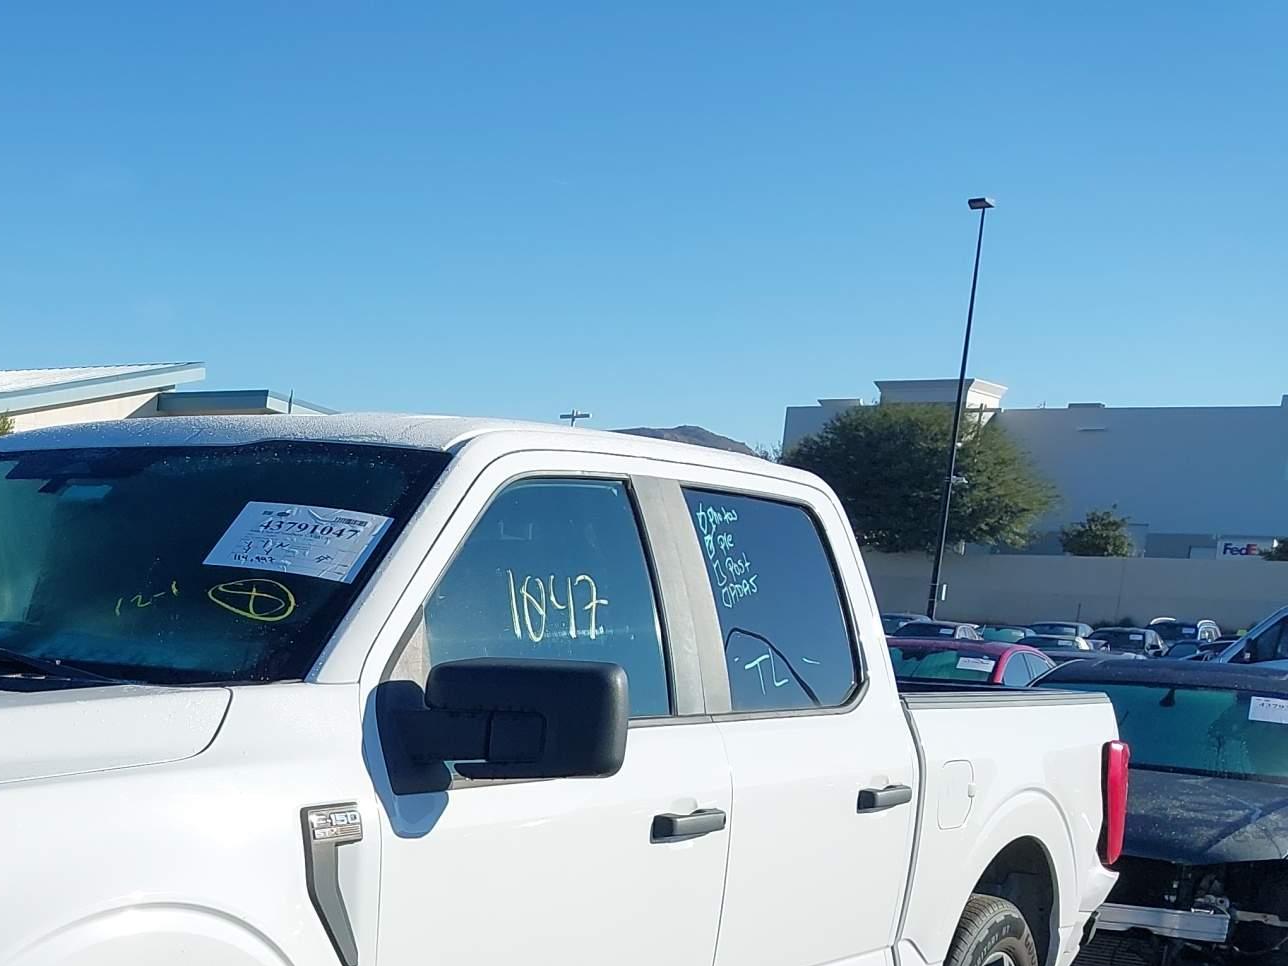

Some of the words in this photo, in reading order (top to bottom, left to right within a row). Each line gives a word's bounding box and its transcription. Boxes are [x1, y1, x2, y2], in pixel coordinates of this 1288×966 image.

[259, 519, 360, 541] 43791047
[1223, 542, 1258, 556] FedE
[726, 552, 750, 582] Post
[507, 568, 608, 642] 1047
[309, 811, 359, 828] F-150
